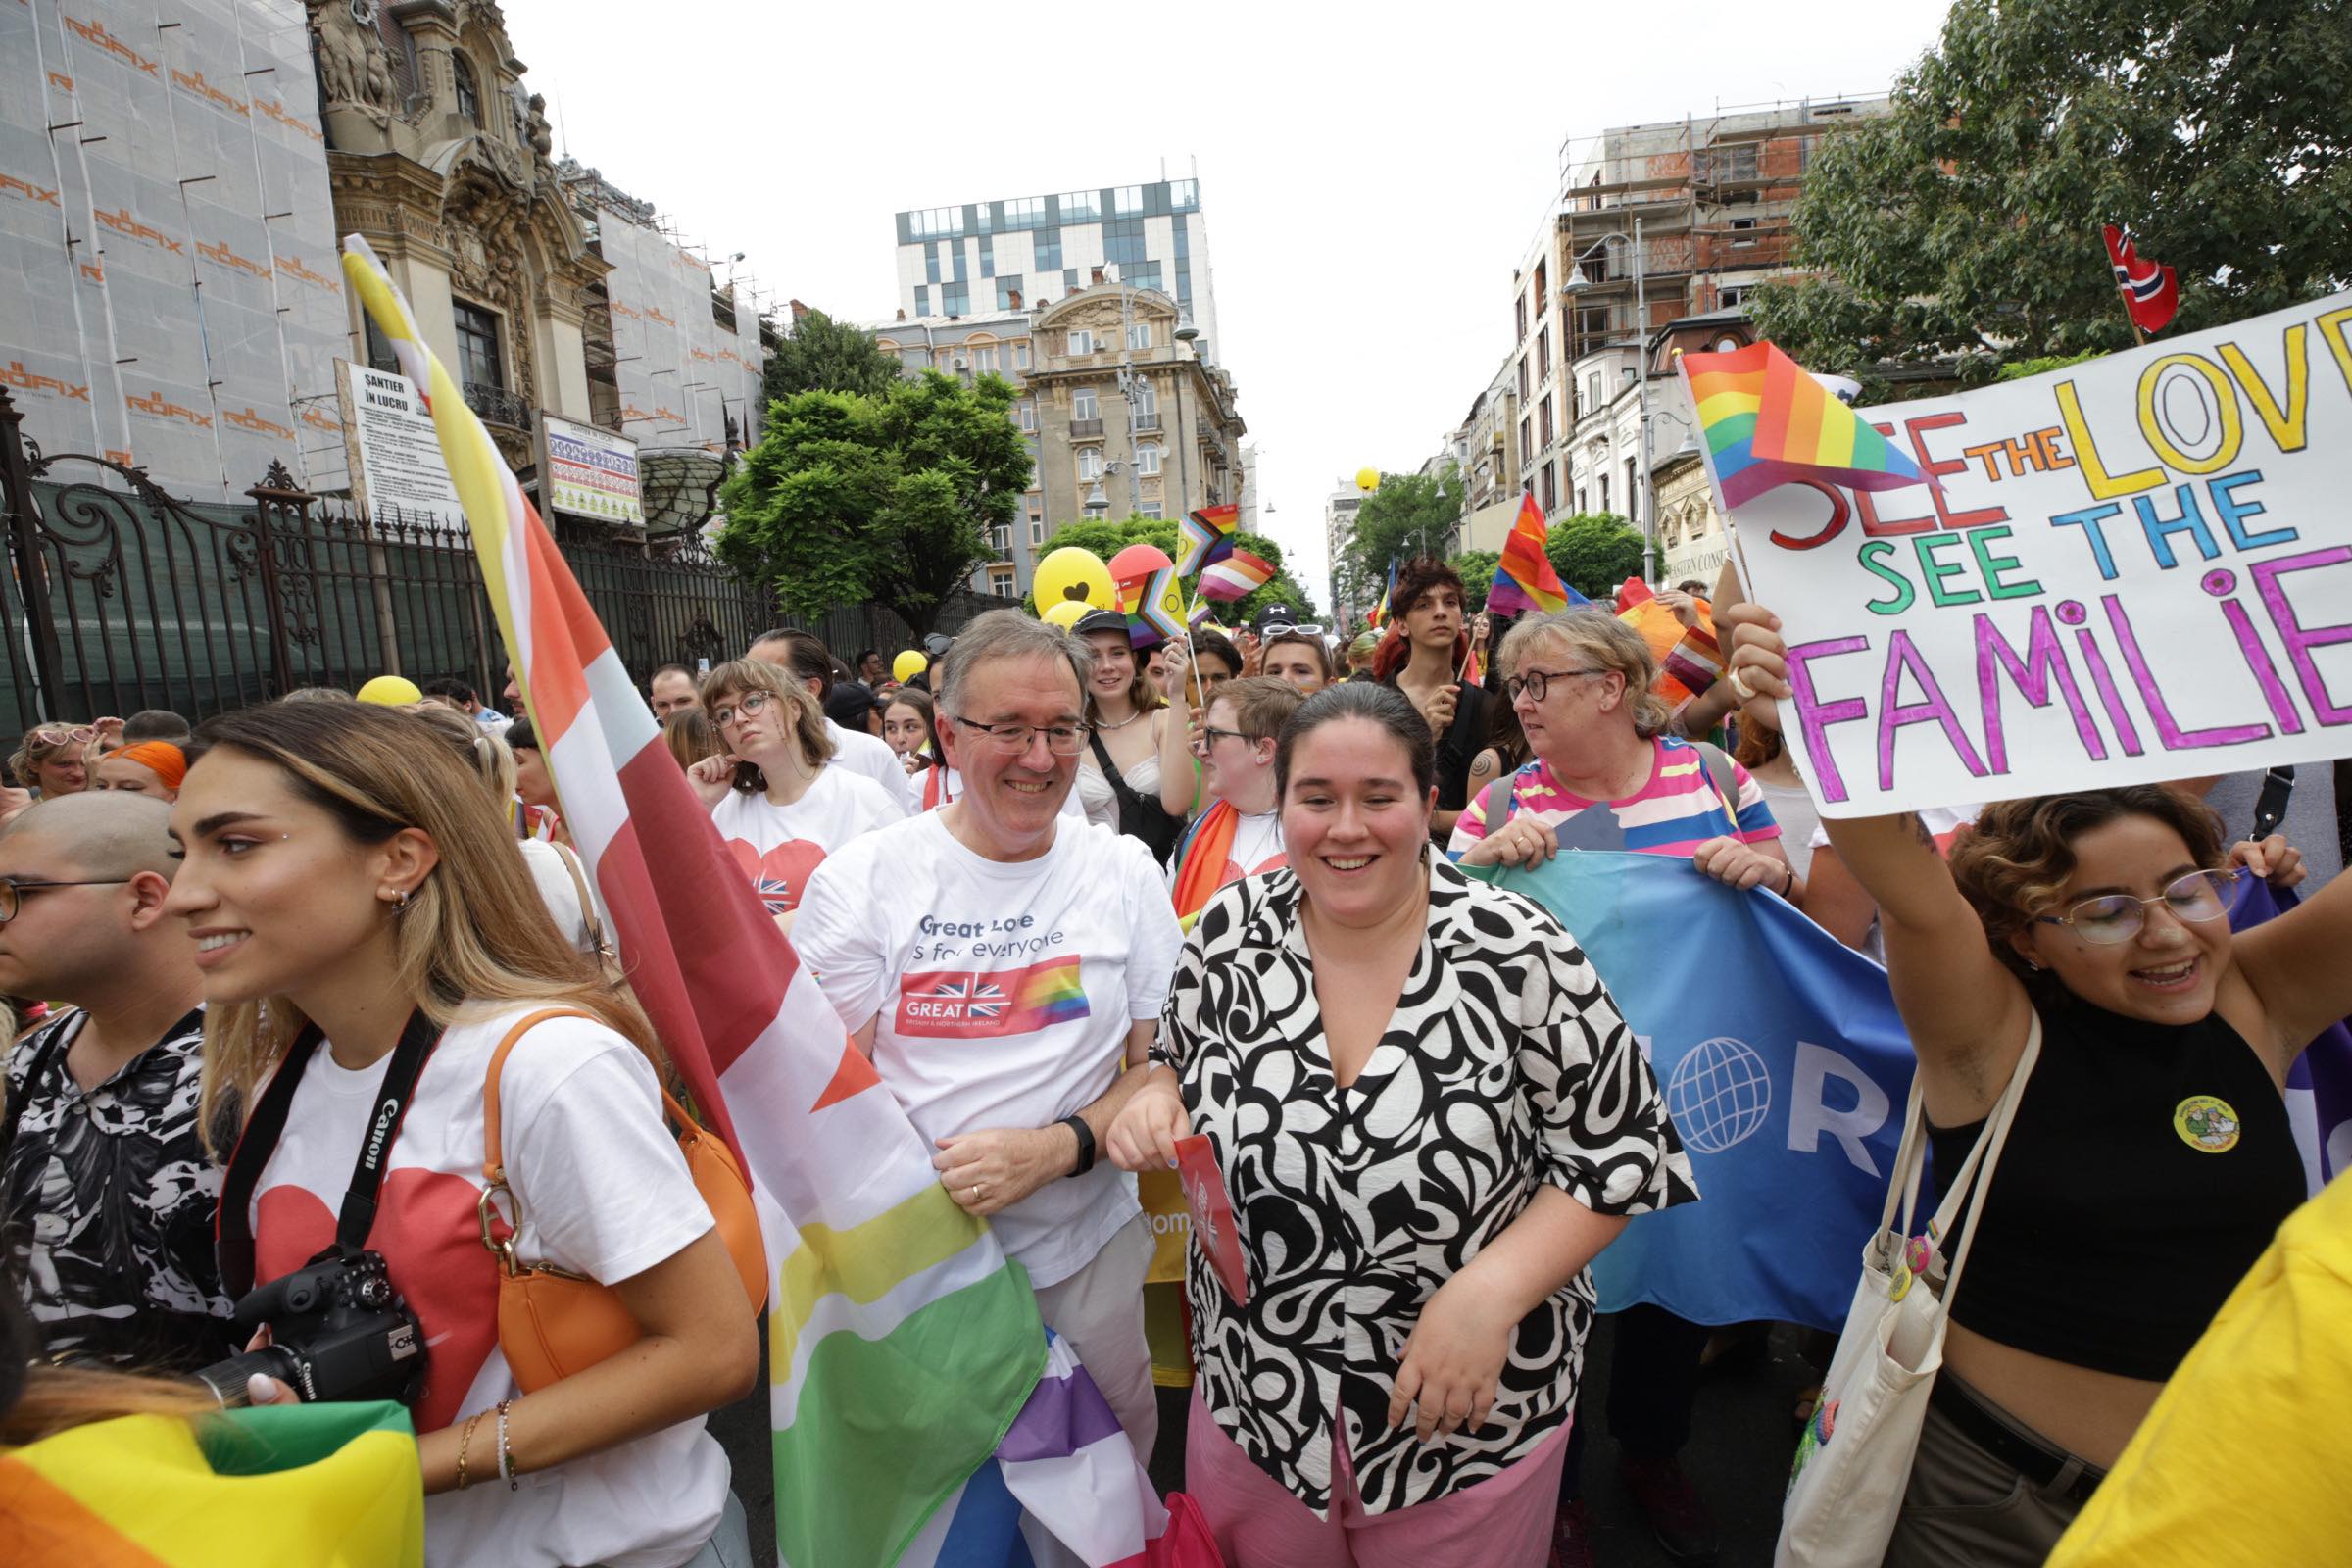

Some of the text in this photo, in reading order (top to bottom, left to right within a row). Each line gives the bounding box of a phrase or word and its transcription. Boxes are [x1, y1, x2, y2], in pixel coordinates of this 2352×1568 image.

[65, 15, 158, 77] RÖFIX
[94, 208, 184, 256] RÖFIX
[125, 391, 213, 429] RÖFIX
[377, 394, 408, 412] LUCRU
[1963, 426, 2077, 482] THE
[1858, 469, 2300, 615] SEE THE
[919, 914, 1034, 938] Great Loe
[933, 942, 962, 961] fo
[906, 1001, 964, 1018] GREAT
[365, 1098, 399, 1170] Canon
[1147, 1212, 1191, 1234] om
[302, 1362, 317, 1400] Canon
